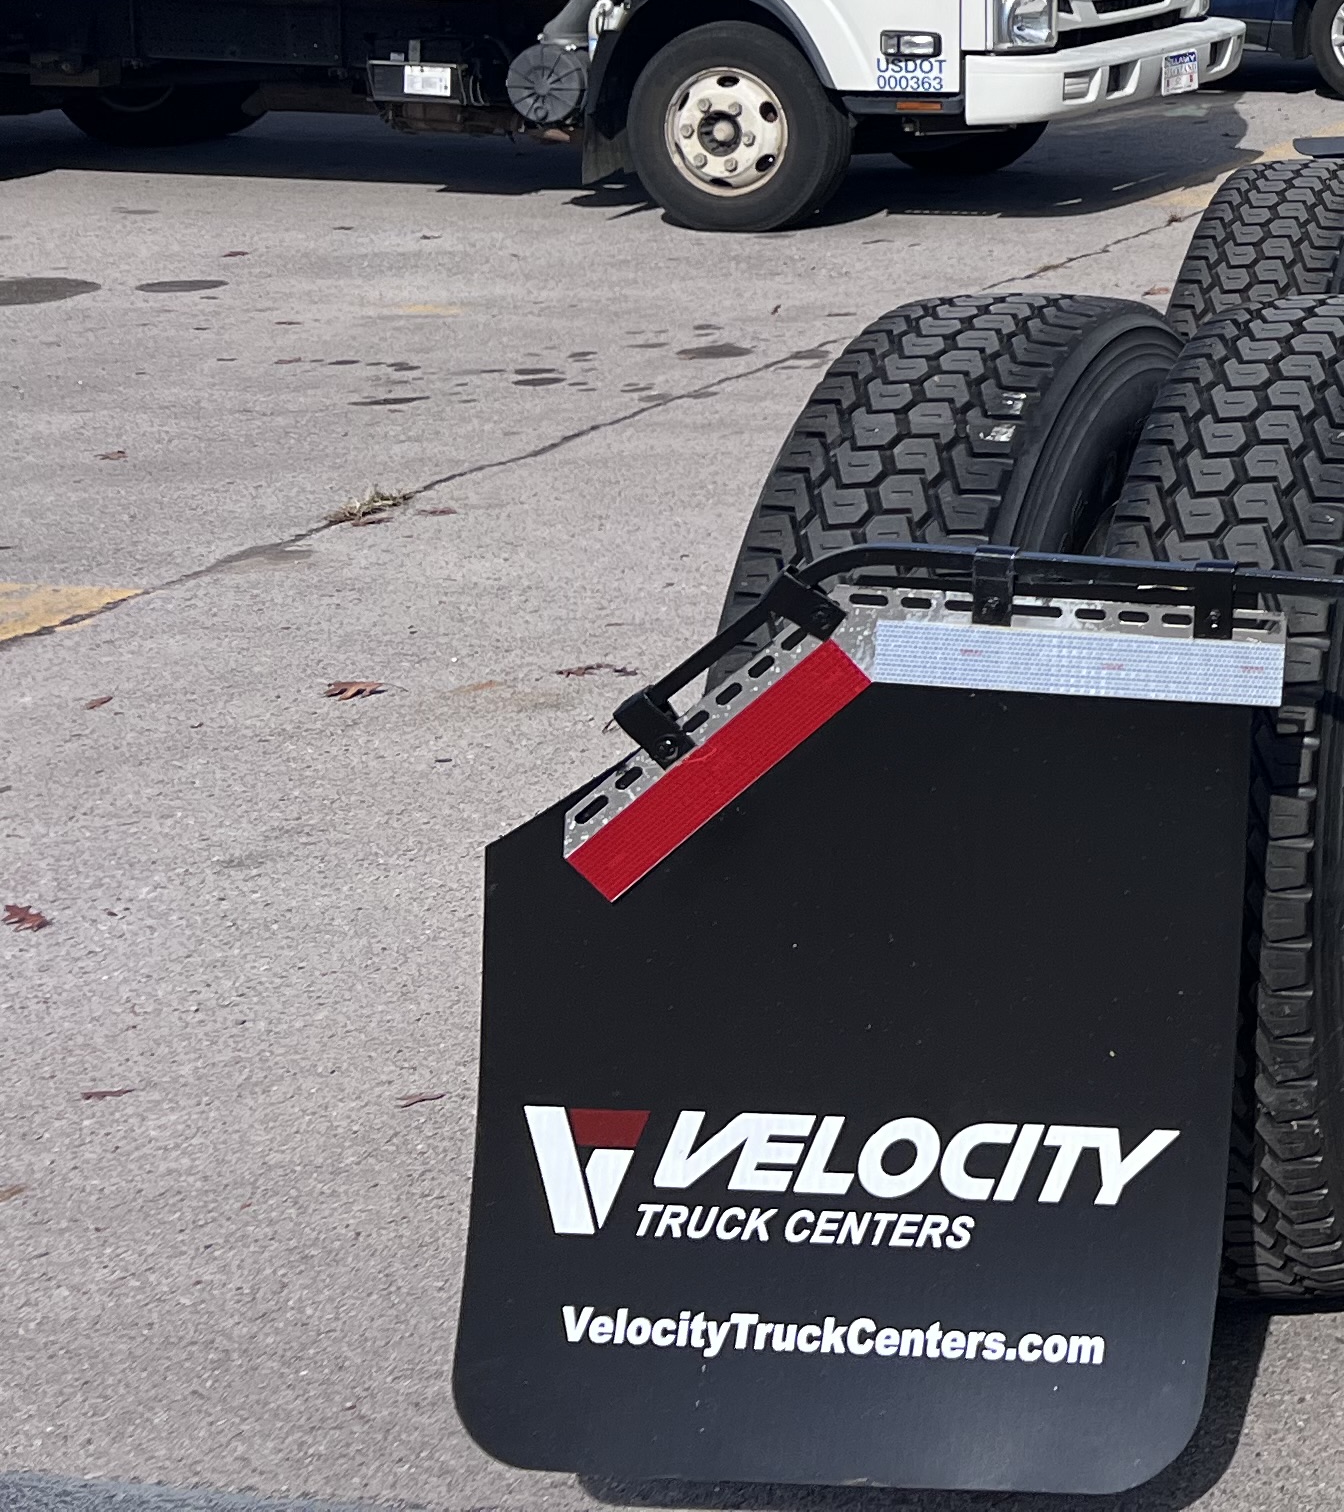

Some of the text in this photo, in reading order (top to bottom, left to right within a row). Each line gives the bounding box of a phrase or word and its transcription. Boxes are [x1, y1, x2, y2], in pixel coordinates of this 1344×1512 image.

[877, 57, 947, 74] USDOT
[877, 75, 943, 91] 000363
[653, 1110, 1181, 1206] VELOCITY
[635, 1203, 975, 1250] TRUCK CENTERS
[562, 1305, 1105, 1365] VelocityTruckCenters.com
